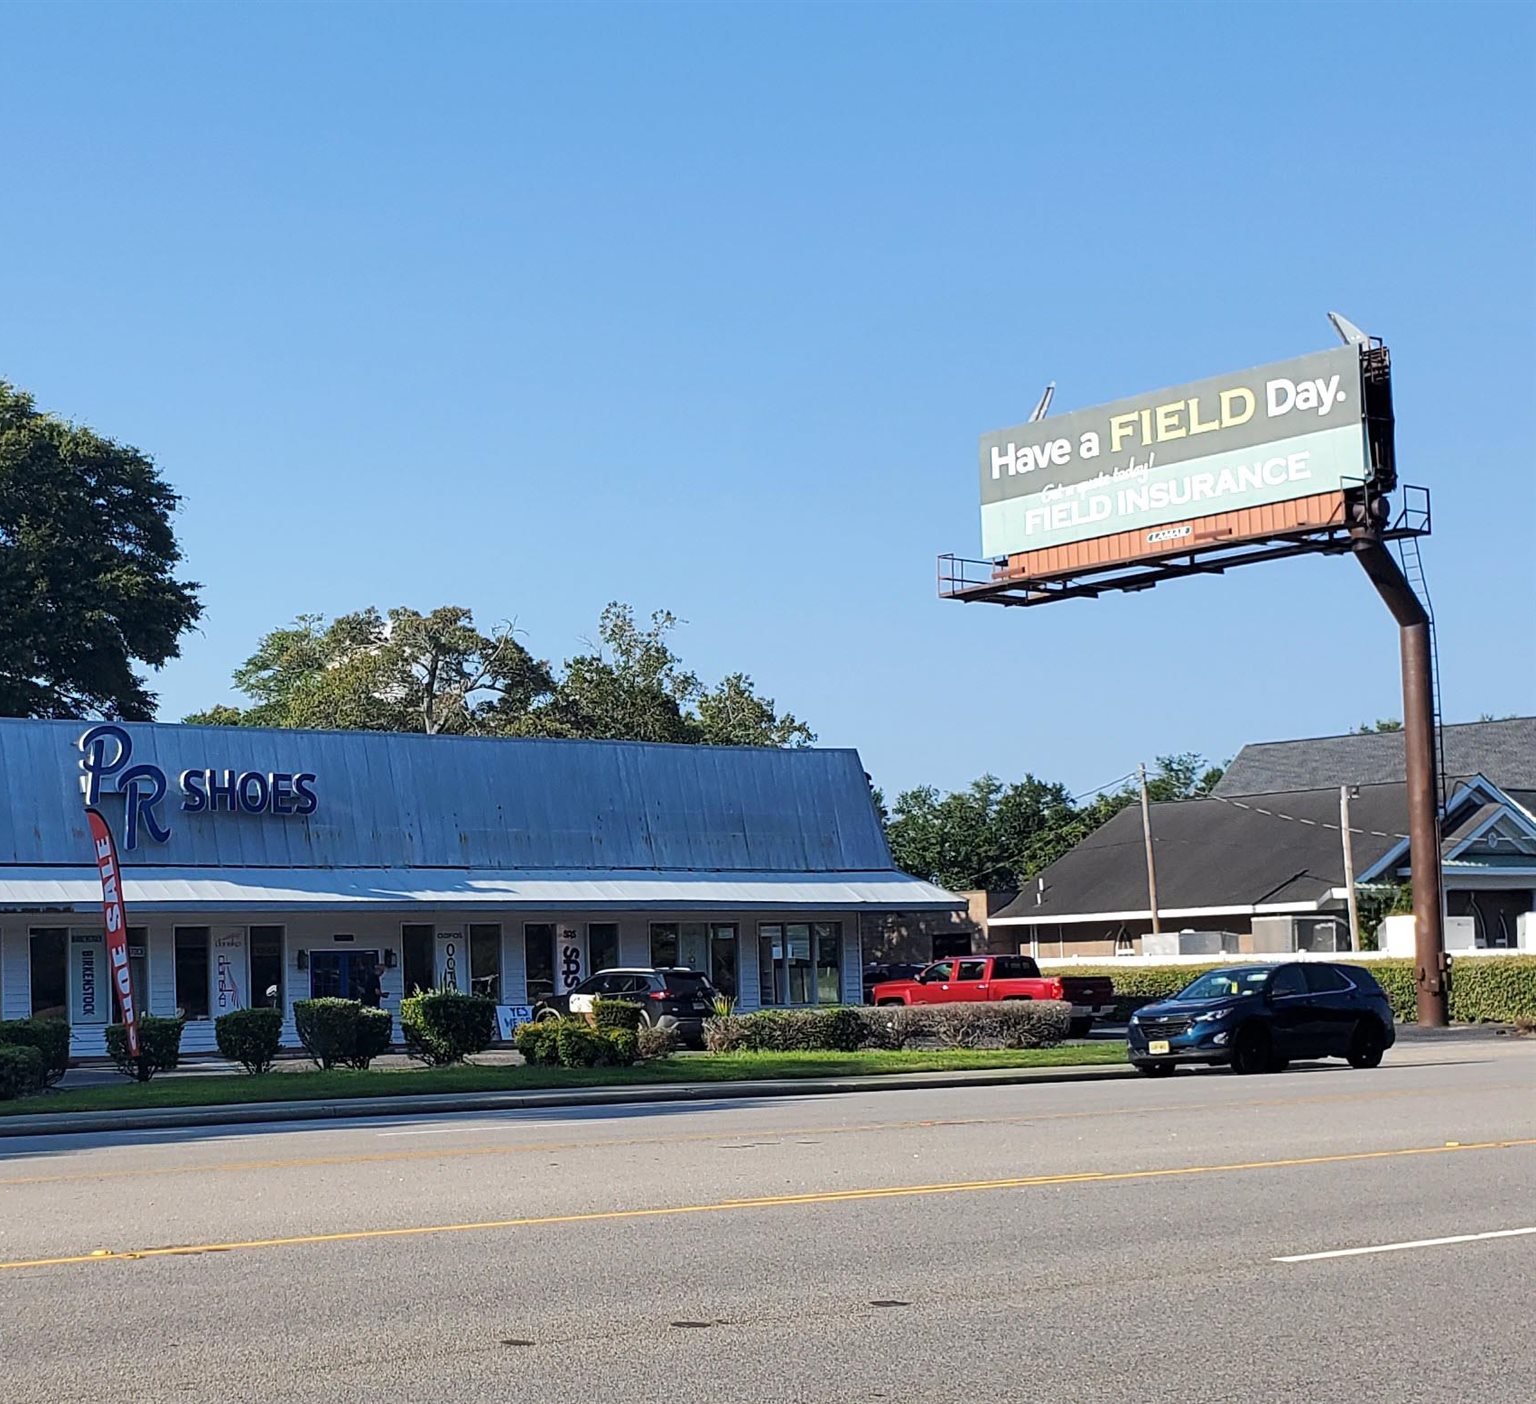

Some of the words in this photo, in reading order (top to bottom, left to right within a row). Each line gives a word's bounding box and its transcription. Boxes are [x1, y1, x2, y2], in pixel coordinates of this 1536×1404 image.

[990, 437, 1073, 480] Have
[1079, 431, 1100, 460] a
[1109, 386, 1256, 453] FIELD
[1266, 374, 1347, 418] Day.
[1025, 494, 1112, 536] FIELD
[1117, 450, 1313, 516] INSURANCE
[78, 725, 171, 851] PR
[180, 769, 319, 815] SHOES
[96, 835, 121, 932] SALE
[82, 950, 95, 1016] BIRKENSTOCK
[562, 945, 581, 988] SAS
[509, 1007, 528, 1017] YES
